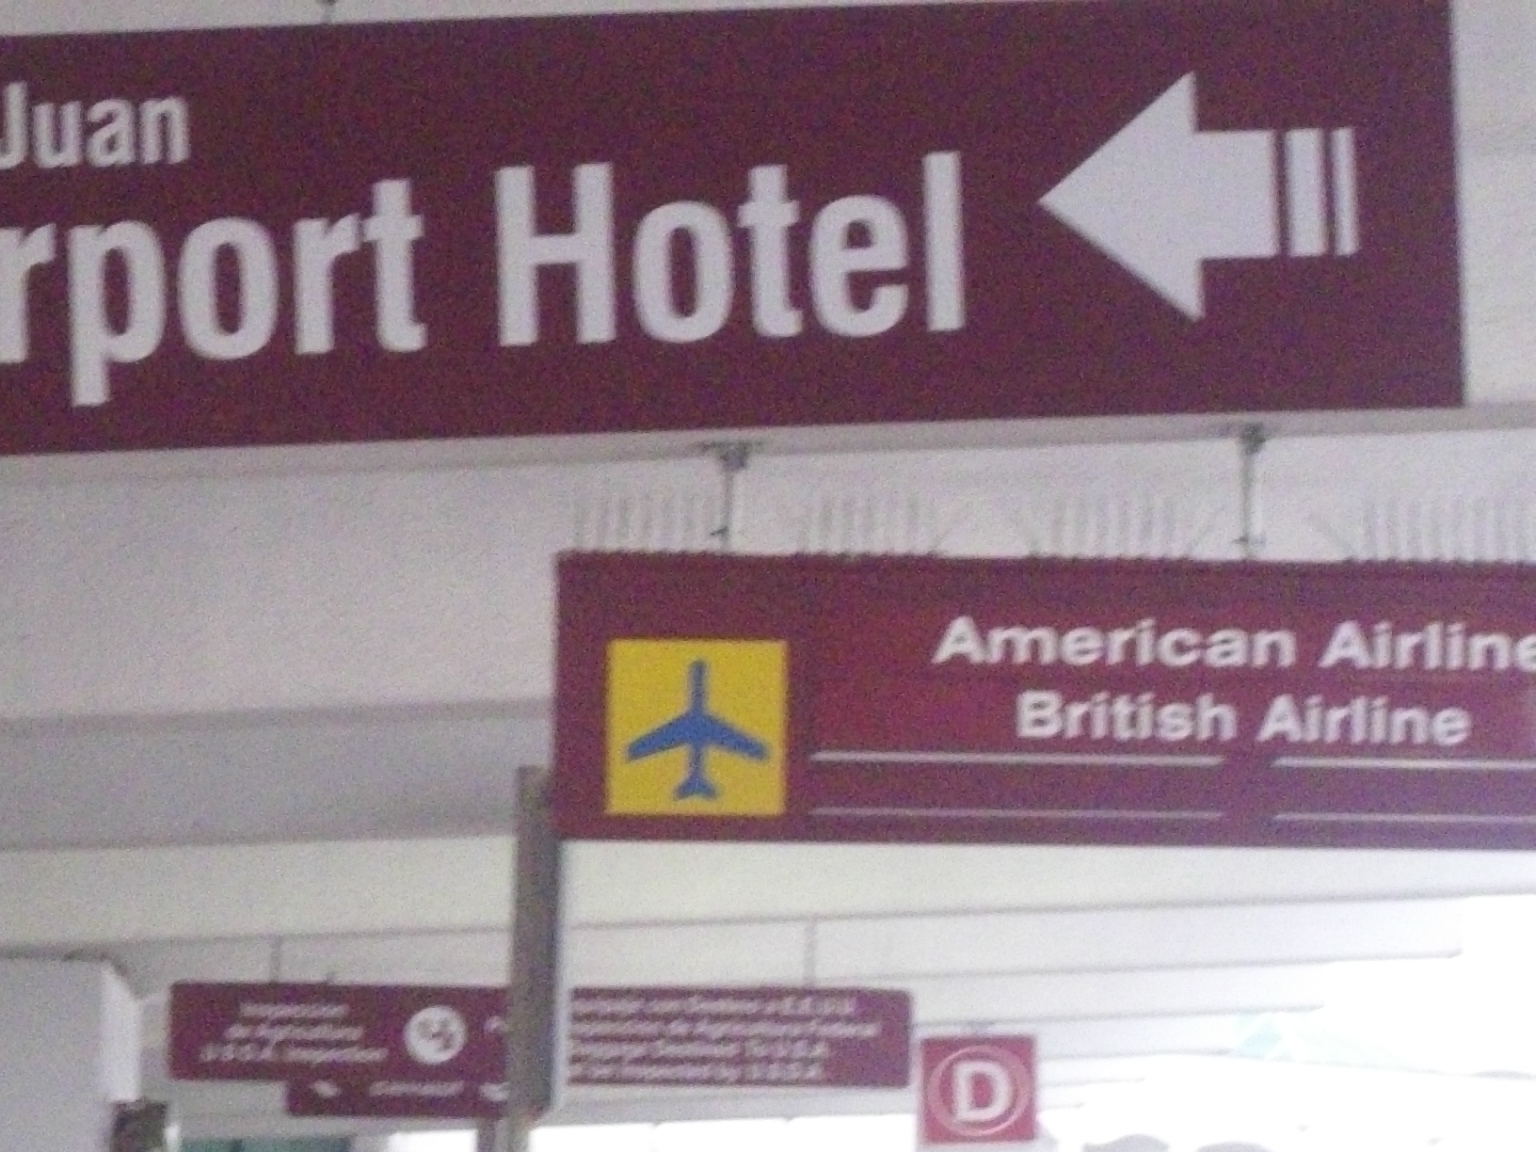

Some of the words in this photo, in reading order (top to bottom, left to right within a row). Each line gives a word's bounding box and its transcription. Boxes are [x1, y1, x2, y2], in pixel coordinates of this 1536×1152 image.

[494, 150, 965, 347] Hotel
[930, 614, 1297, 668] American
[1016, 689, 1238, 741] British
[1257, 693, 1473, 745] Airline
[953, 1060, 1011, 1122] D
